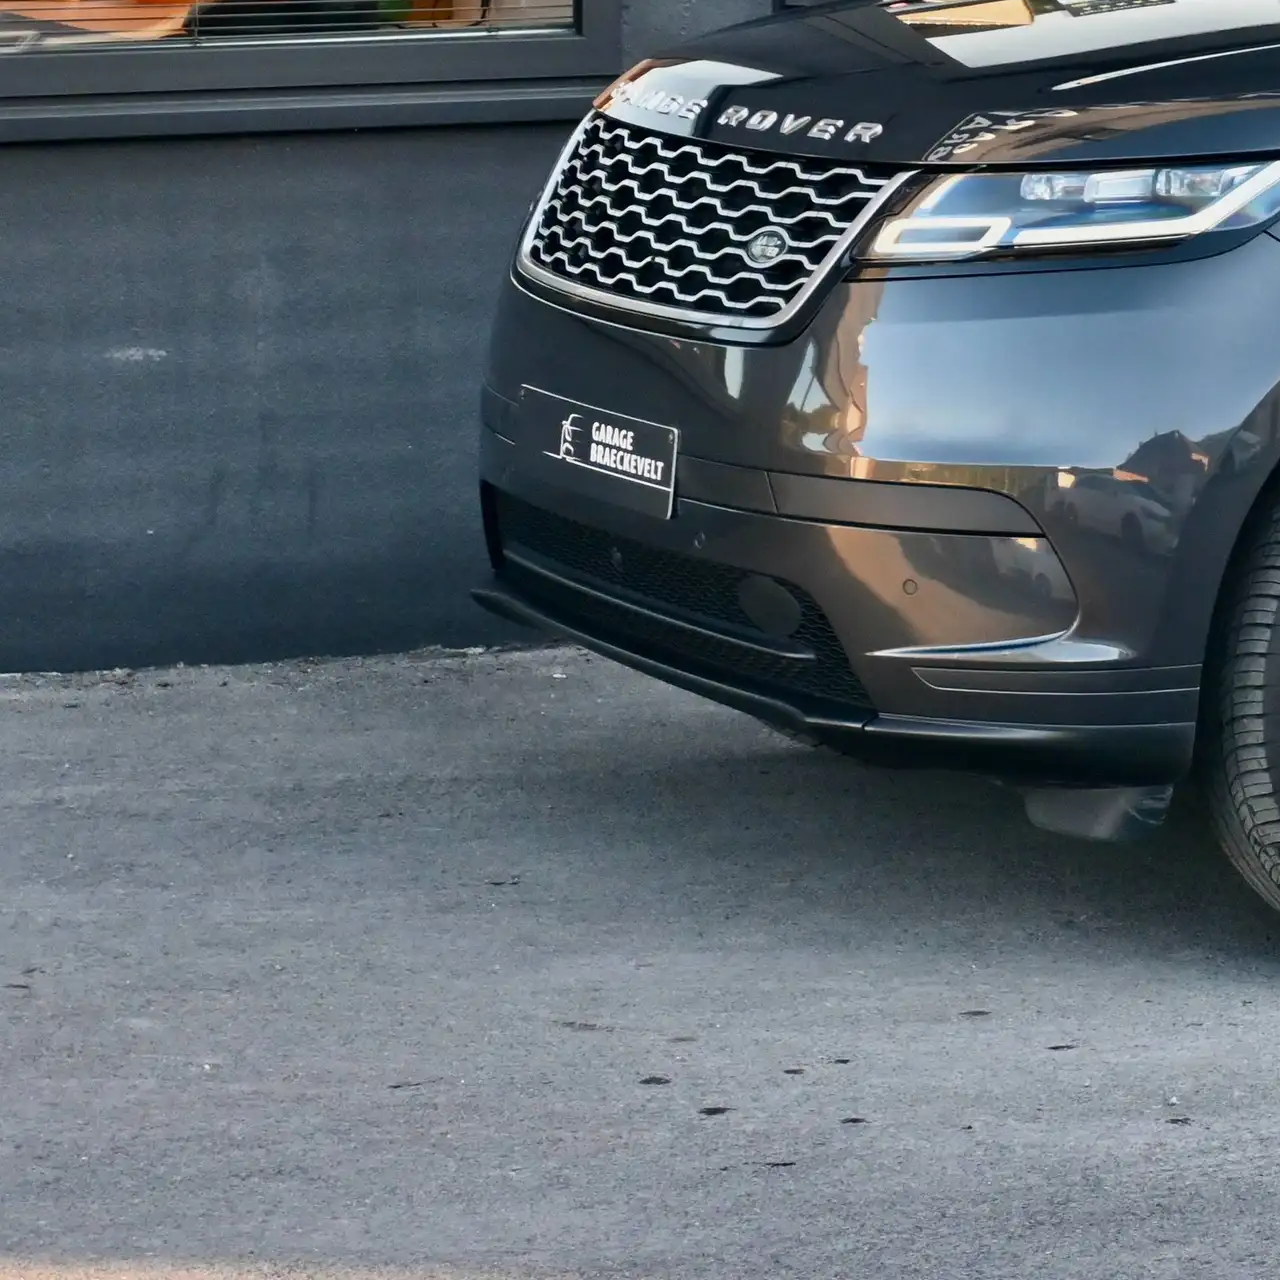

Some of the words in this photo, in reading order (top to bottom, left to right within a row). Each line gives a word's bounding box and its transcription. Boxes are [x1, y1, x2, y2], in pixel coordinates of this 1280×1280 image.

[717, 104, 884, 144] ROVER
[591, 421, 635, 451] GARAGE
[589, 442, 665, 481] BRAECKEVELT
